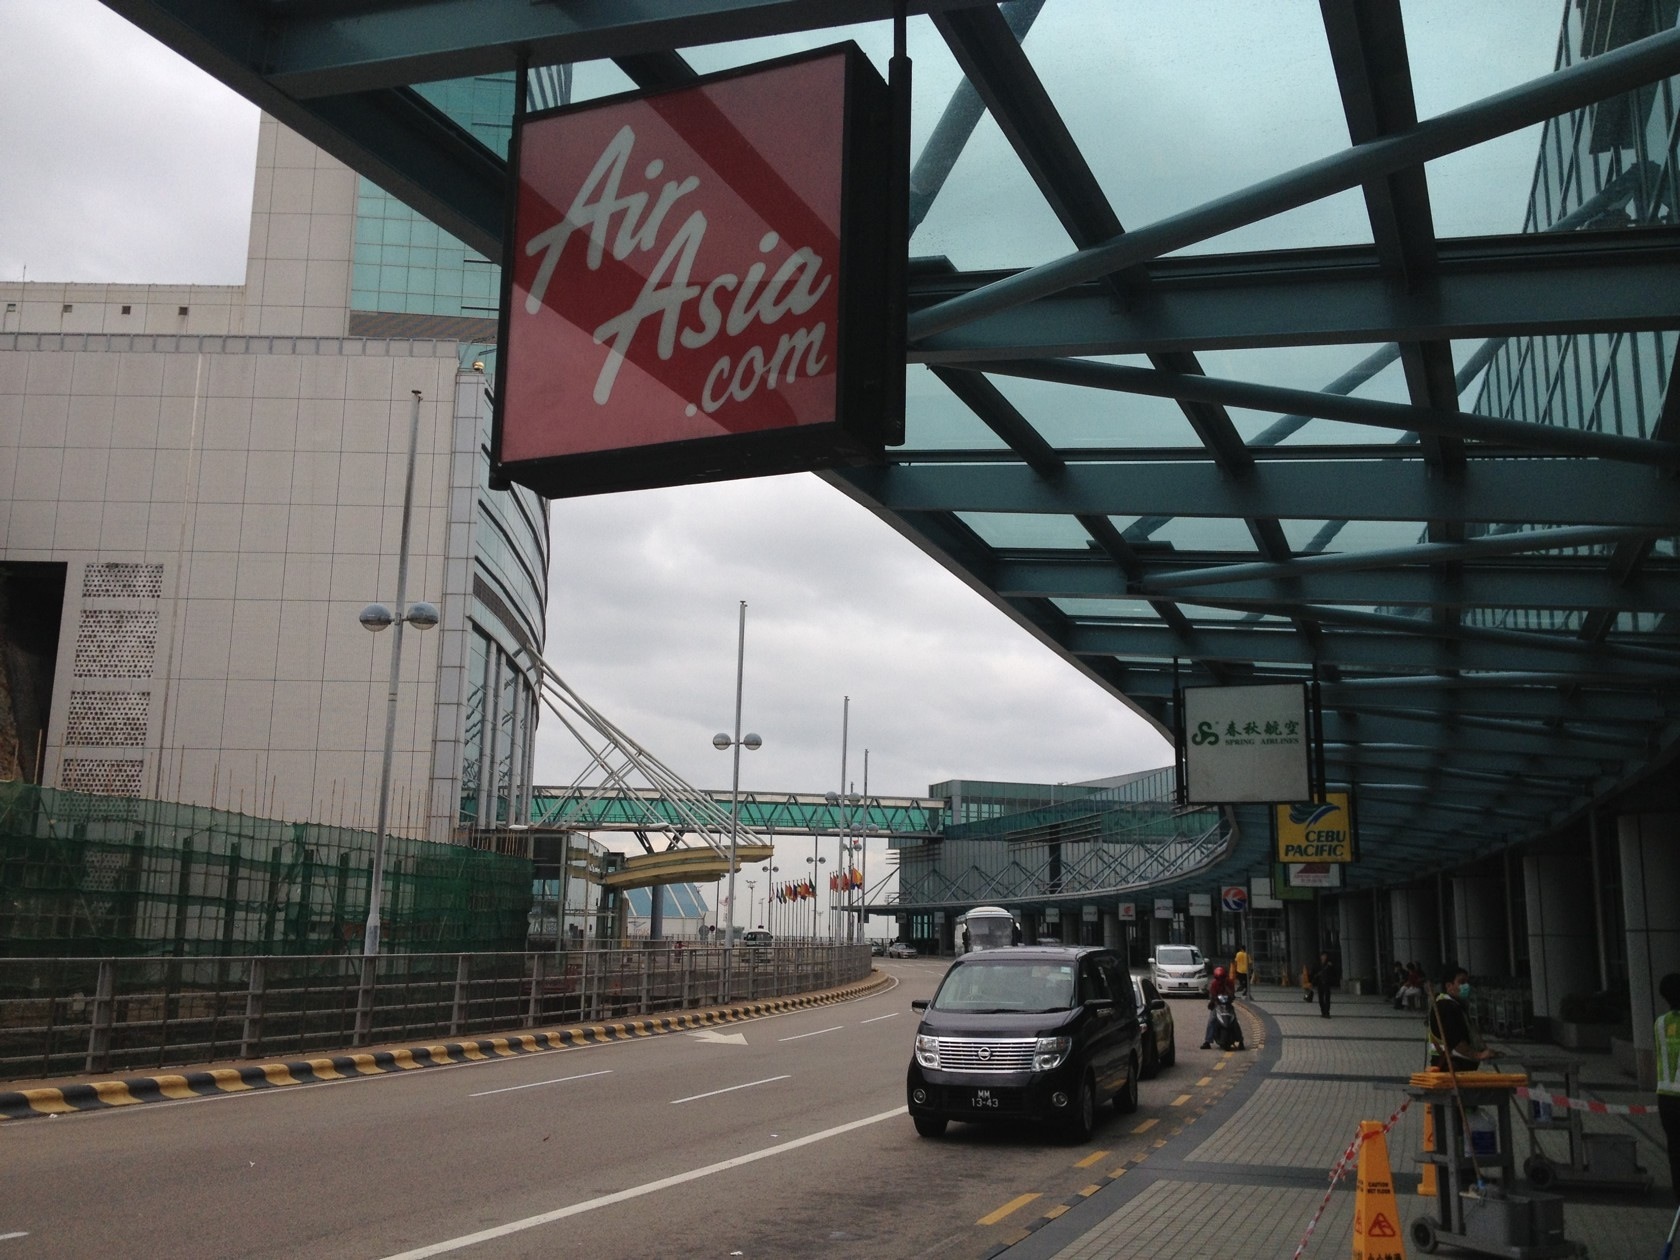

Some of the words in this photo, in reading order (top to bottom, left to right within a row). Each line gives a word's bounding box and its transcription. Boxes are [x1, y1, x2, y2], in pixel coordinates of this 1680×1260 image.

[525, 125, 700, 315] Air
[593, 210, 831, 405] Asia
[685, 321, 828, 417] .com
[1285, 843, 1344, 857] PACIFIC
[1305, 830, 1346, 843] CEBU
[971, 1098, 999, 1107] 13-43
